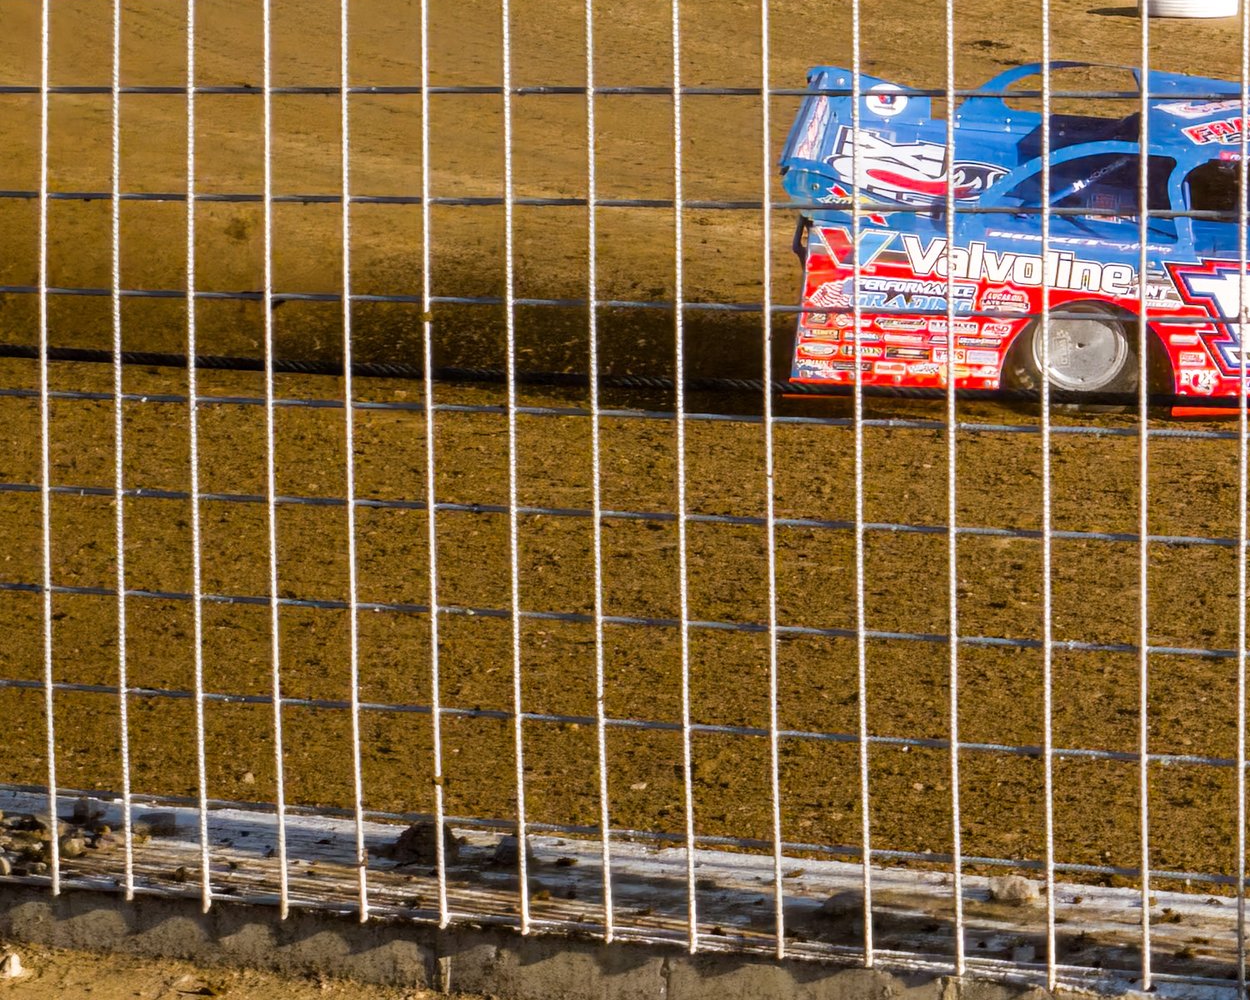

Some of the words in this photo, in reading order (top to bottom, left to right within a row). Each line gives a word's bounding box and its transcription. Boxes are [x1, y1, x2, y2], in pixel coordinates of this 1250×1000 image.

[902, 233, 1135, 296] Valvoline
[984, 324, 1010, 334] MSD
[1180, 369, 1218, 391] FOX
